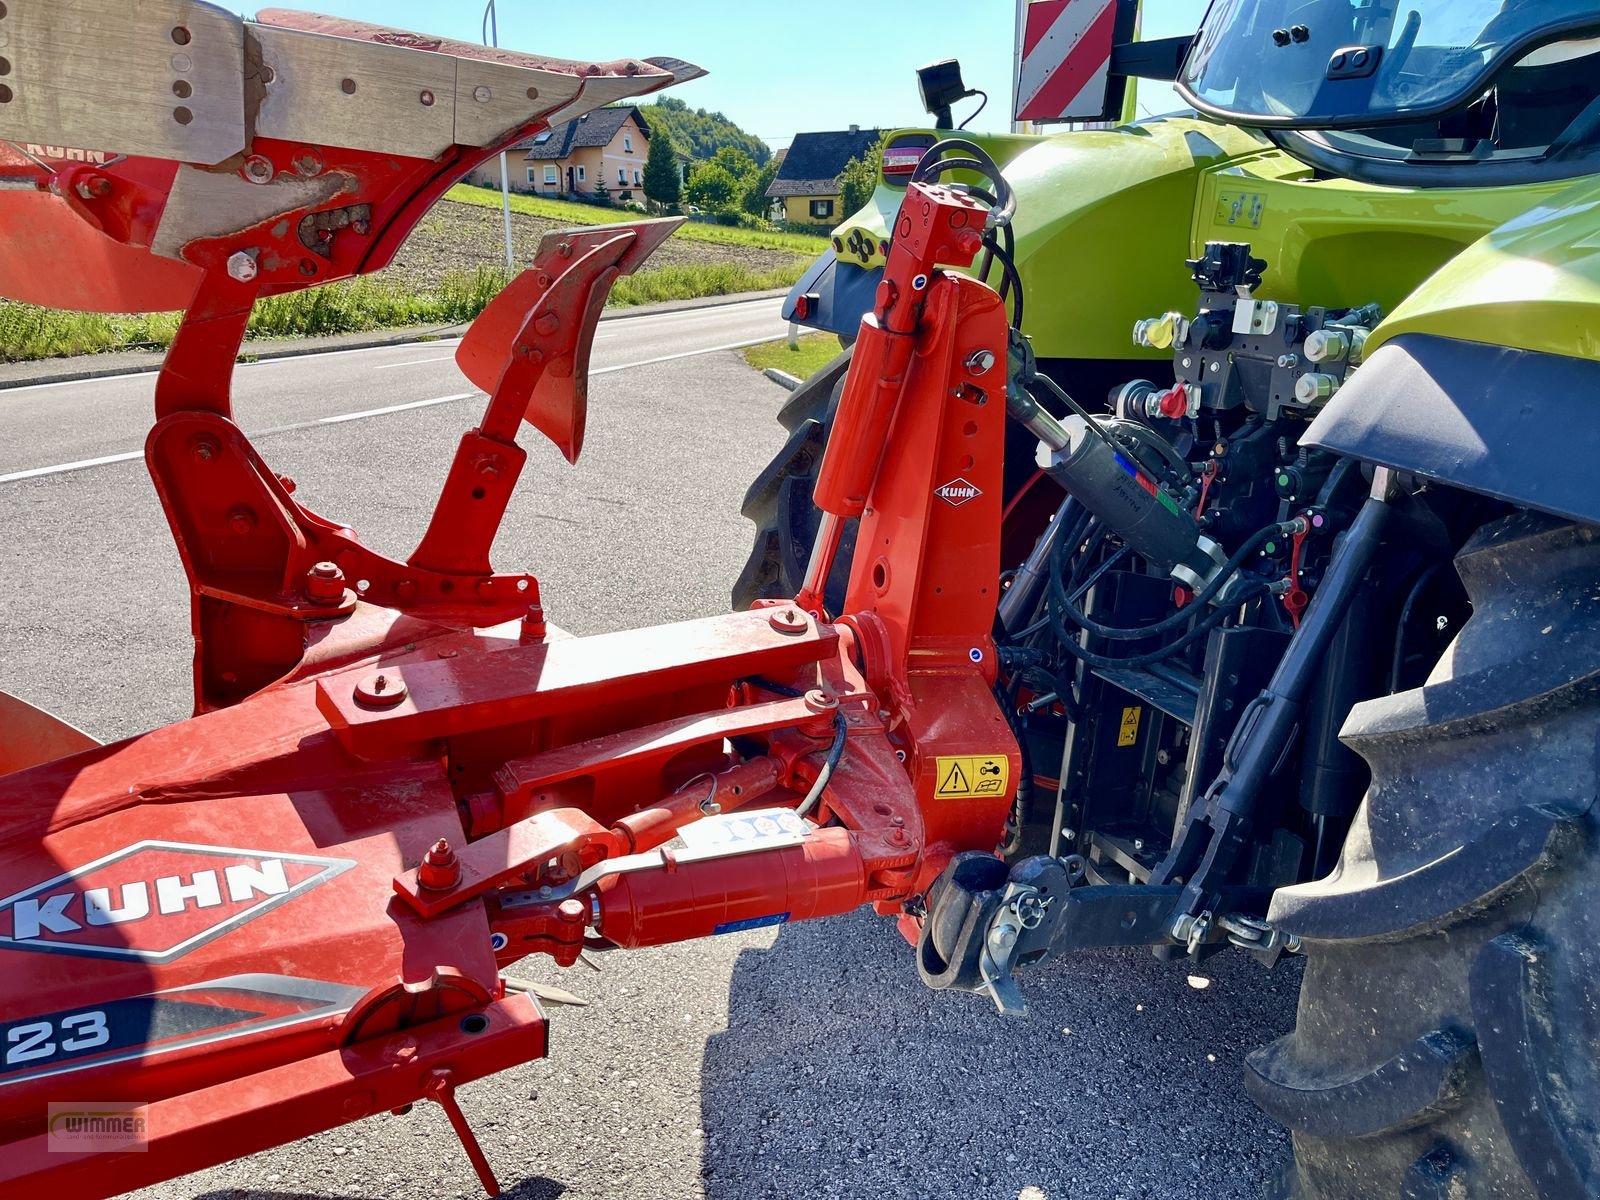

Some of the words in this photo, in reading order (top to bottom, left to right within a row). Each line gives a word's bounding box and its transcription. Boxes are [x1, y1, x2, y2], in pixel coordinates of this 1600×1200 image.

[941, 487, 975, 498] KUHN
[13, 858, 290, 941] KUHN
[6, 1010, 110, 1065] 23
